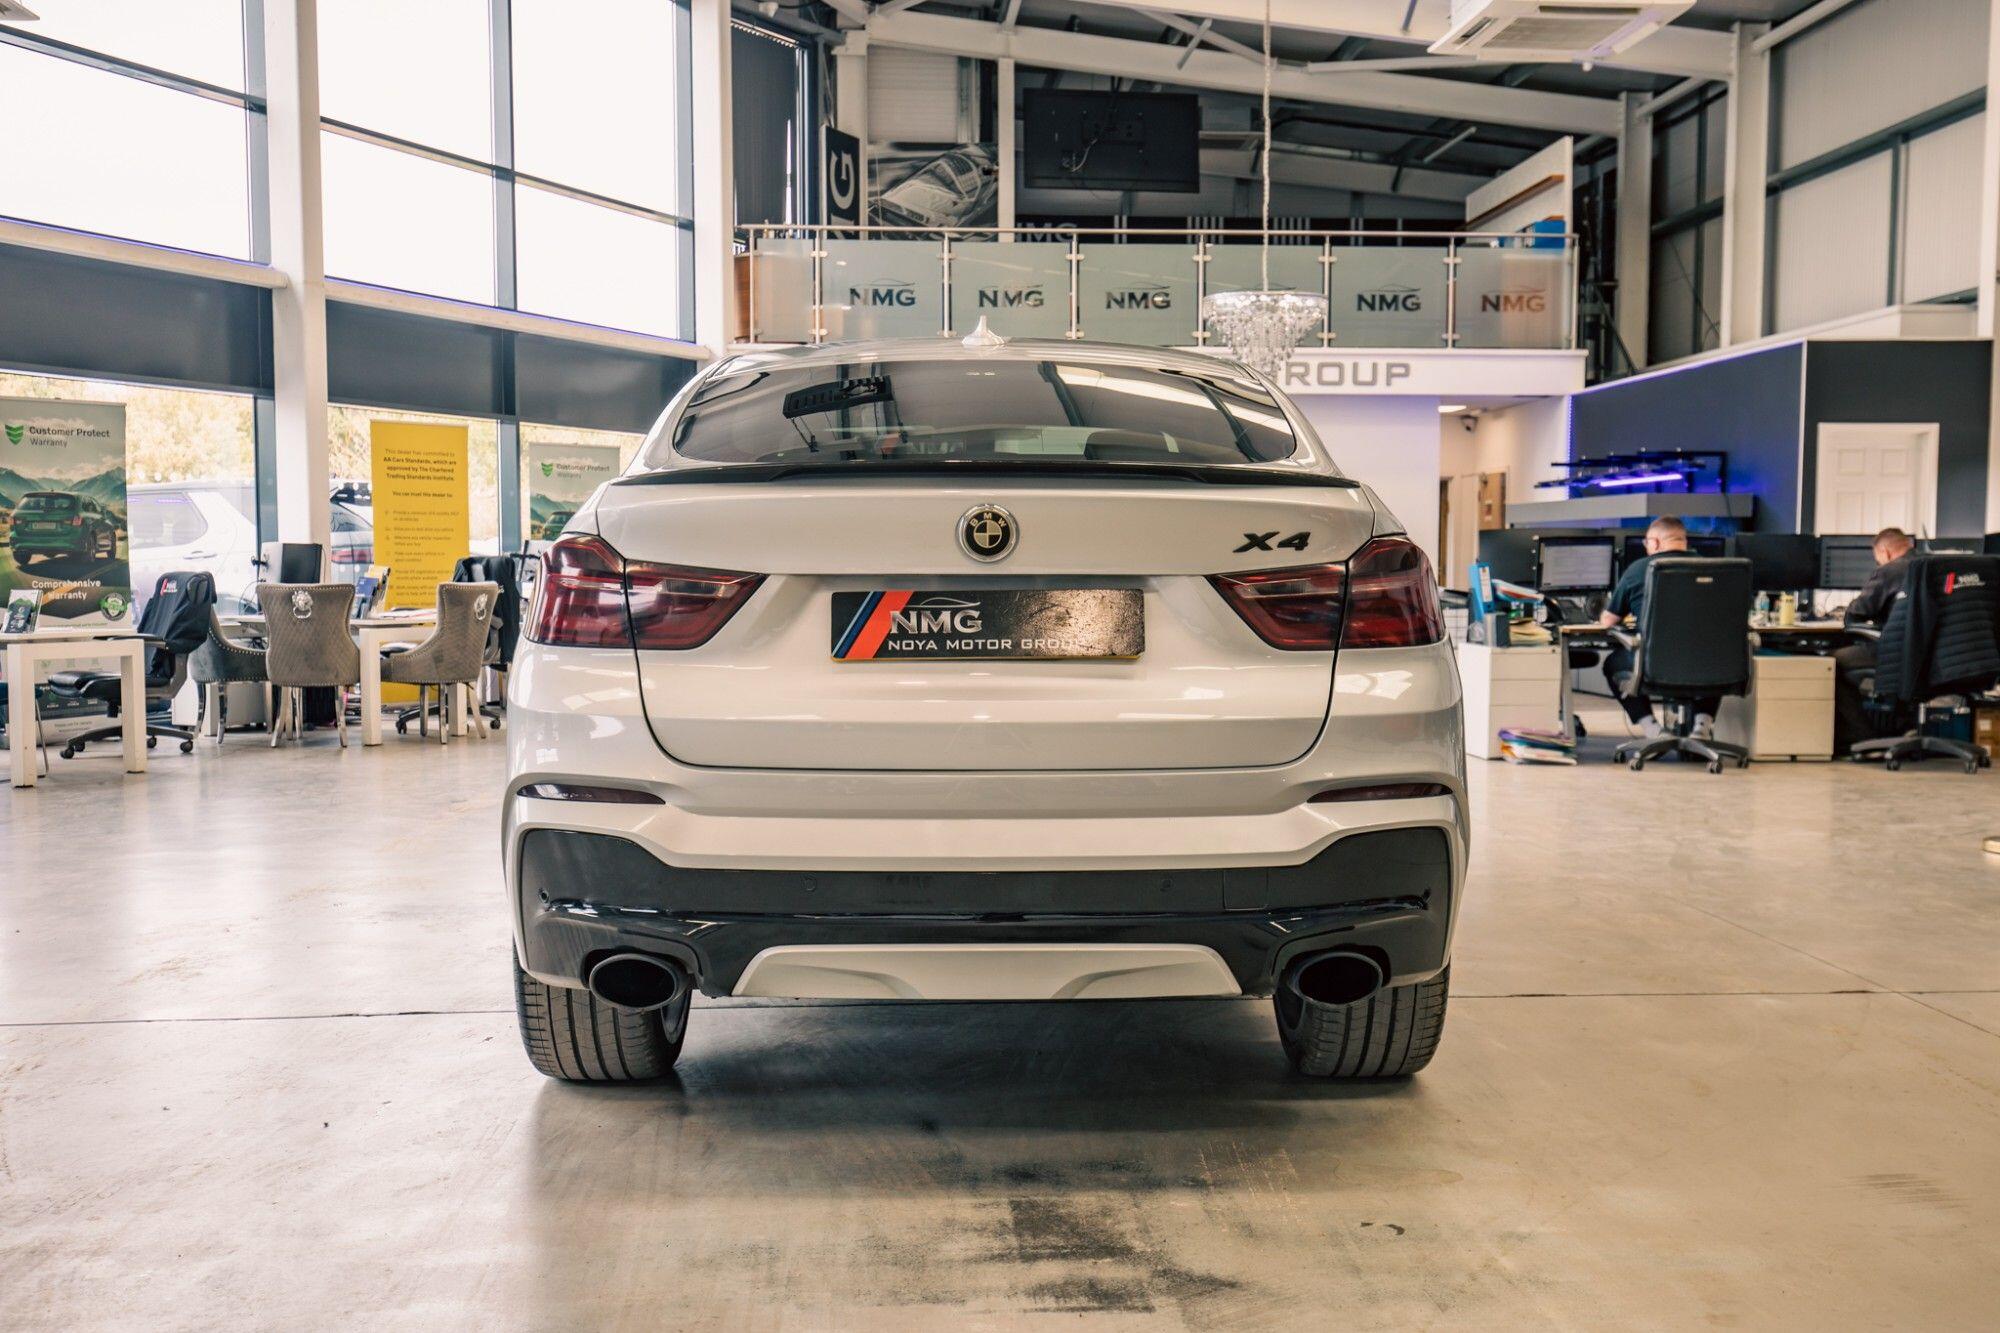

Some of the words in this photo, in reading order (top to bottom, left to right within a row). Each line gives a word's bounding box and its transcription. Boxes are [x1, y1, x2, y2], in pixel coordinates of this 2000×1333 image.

[849, 288, 916, 307] NMG
[979, 289, 1044, 308] NMG
[1105, 291, 1171, 310] NMG
[1357, 294, 1421, 312] NMG
[1481, 295, 1546, 312] NMG
[1274, 361, 1411, 386] ROUP
[29, 426, 74, 436] Customer
[76, 428, 110, 438] Protect
[30, 438, 68, 448] Warranty
[970, 512, 1007, 528] BMW
[1231, 531, 1311, 553] X4
[31, 579, 101, 590] Comprehensive
[890, 609, 983, 634] NMG
[888, 640, 938, 651] NOYA
[946, 639, 1012, 650] MOTOR
